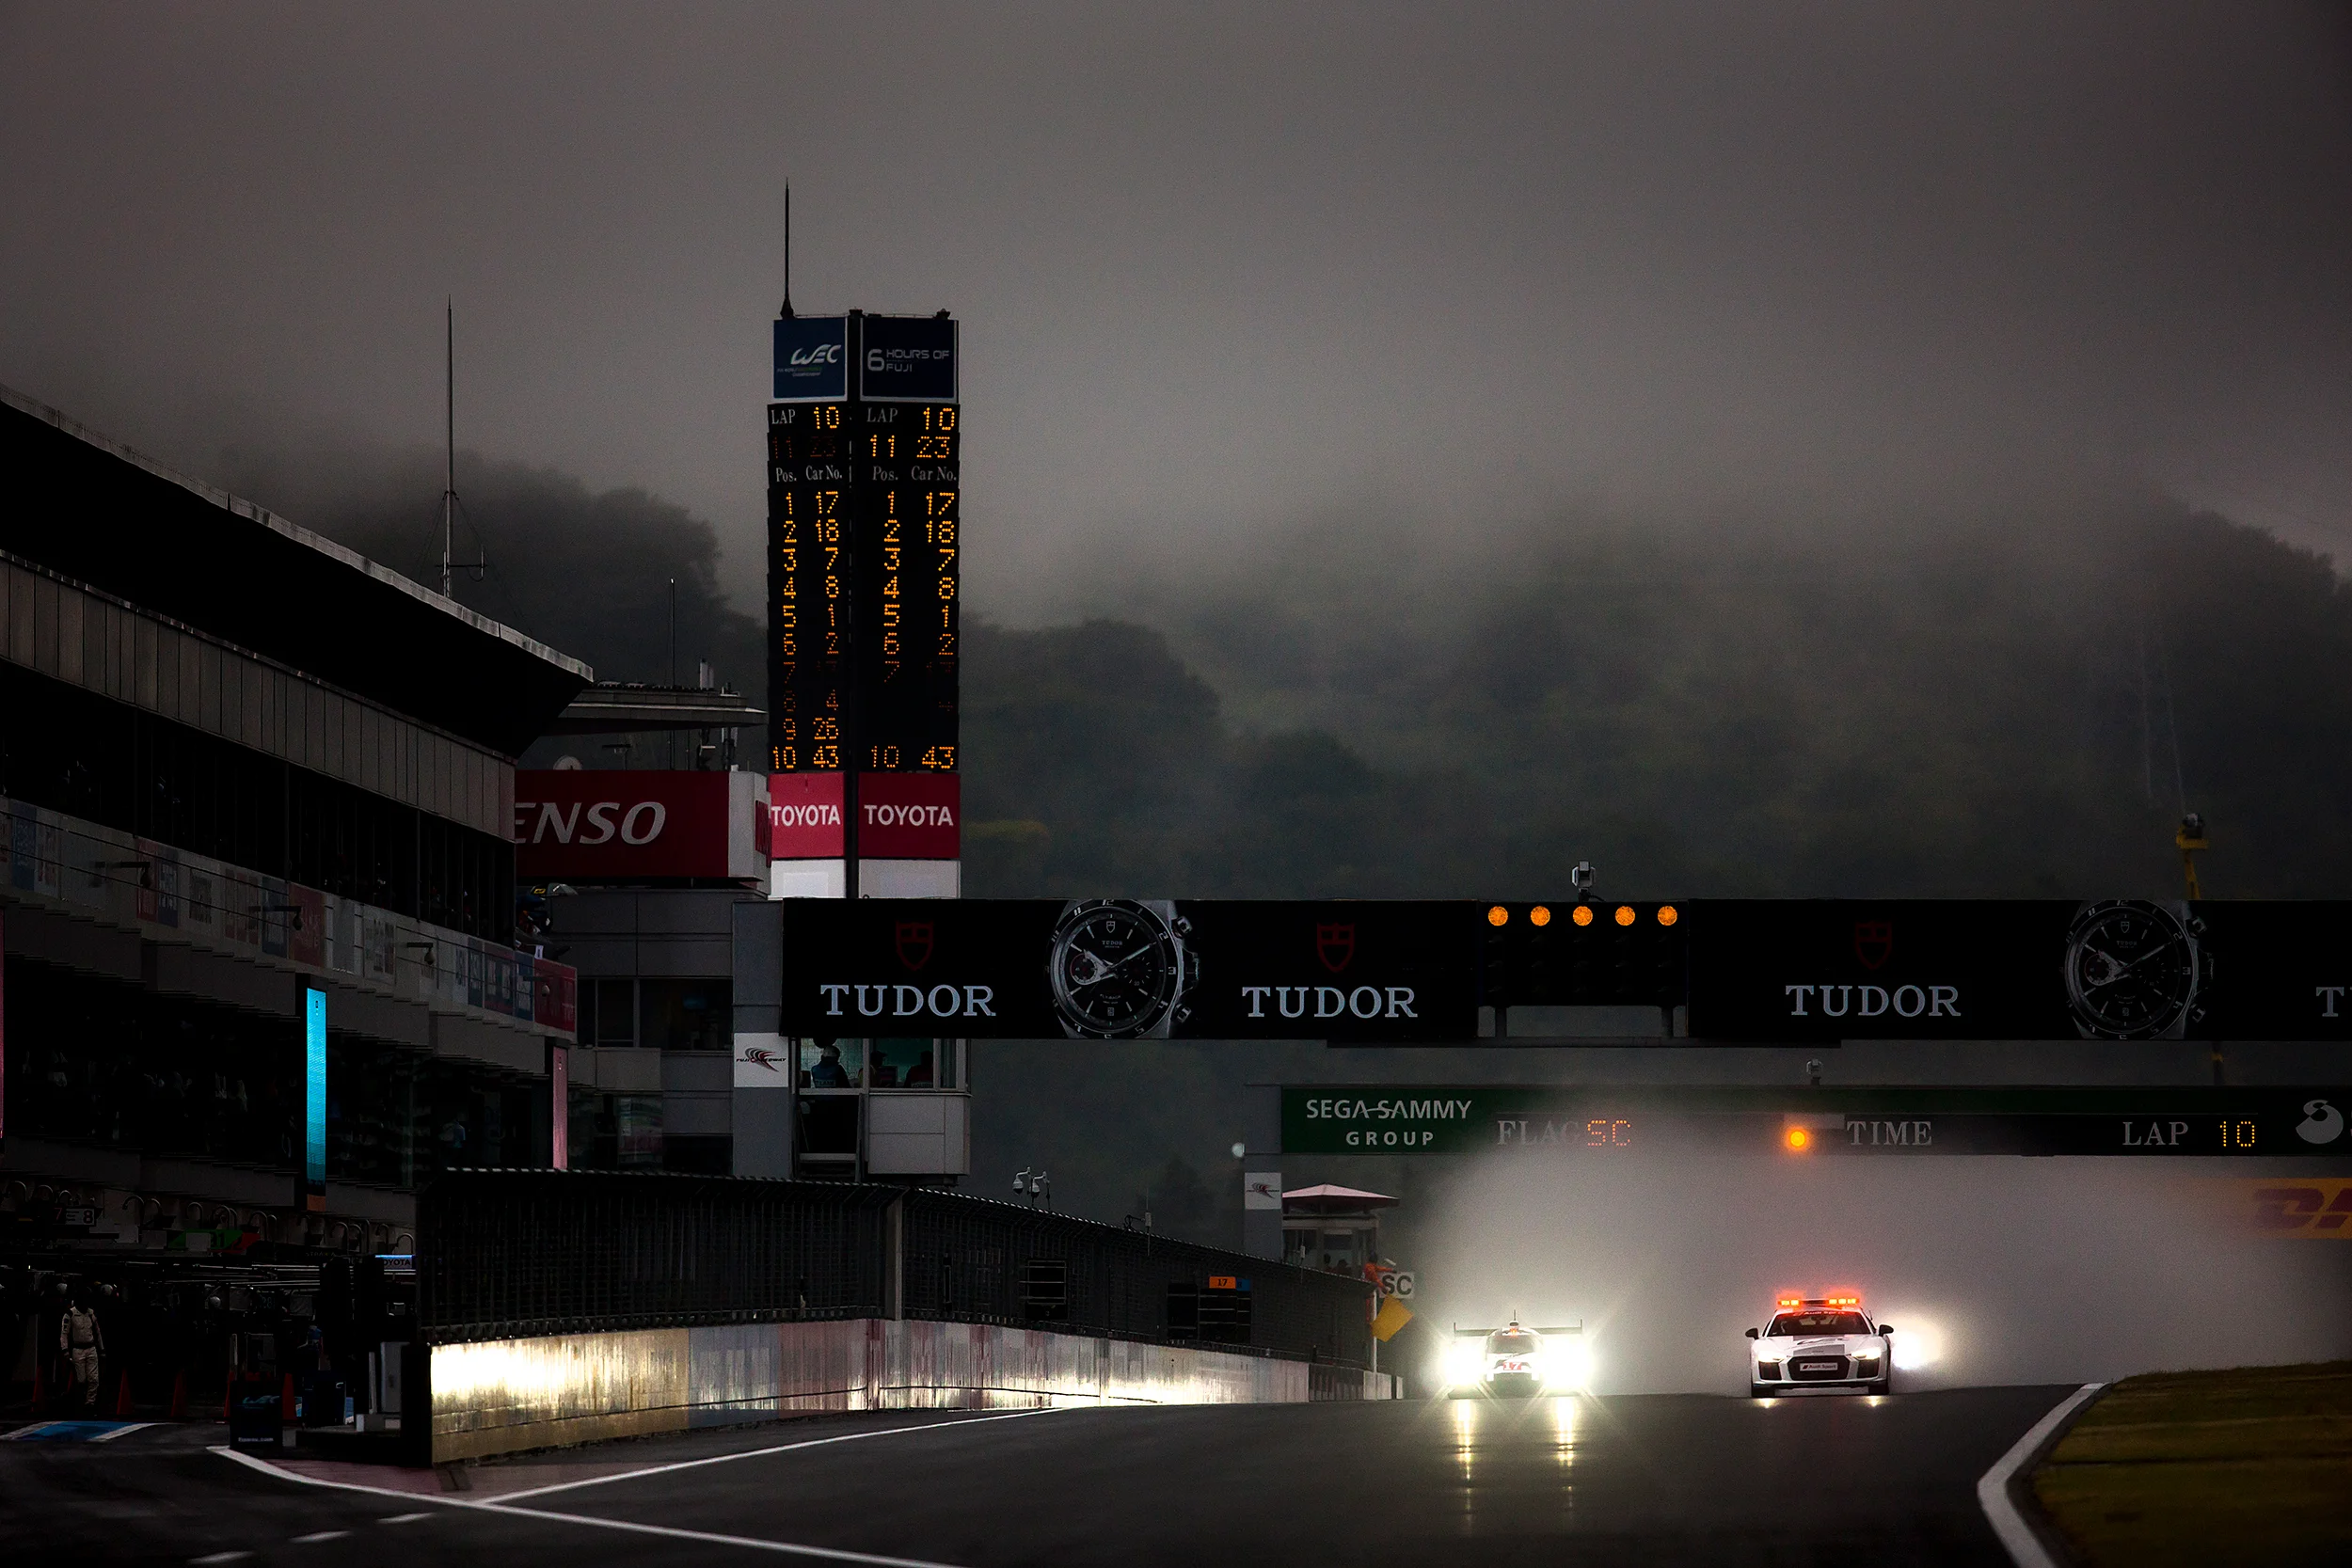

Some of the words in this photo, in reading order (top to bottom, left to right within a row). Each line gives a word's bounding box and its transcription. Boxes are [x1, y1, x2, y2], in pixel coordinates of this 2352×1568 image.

[790, 344, 842, 365] WEC
[867, 348, 884, 372] 6
[885, 349, 930, 359] HOURS
[932, 349, 950, 360] OF
[885, 363, 913, 372] FUJI
[771, 408, 796, 425] LAP
[813, 406, 840, 429] 10
[866, 407, 898, 423] LAP
[923, 407, 955, 431] 10
[870, 434, 895, 457] 11
[916, 436, 950, 458] 23
[775, 466, 798, 483] Pos.
[805, 466, 824, 481] Car
[826, 465, 843, 481] No.
[872, 466, 899, 482] Pos.
[911, 466, 933, 481] Car
[936, 467, 957, 482] No.
[786, 491, 793, 515] 1
[816, 490, 839, 515] 17
[887, 490, 895, 515] 1
[926, 491, 955, 515] 17
[784, 520, 797, 543] 2
[815, 518, 839, 543] 18
[883, 519, 900, 543] 2
[926, 519, 955, 543] 18
[783, 547, 797, 571] 3
[825, 546, 839, 571] 7
[884, 546, 900, 571] 3
[938, 548, 955, 571] 7
[784, 576, 797, 599] 4
[825, 575, 839, 598] 8
[883, 576, 900, 599] 4
[938, 577, 955, 600] 8
[783, 604, 797, 628] 5
[828, 603, 835, 626] 1
[883, 604, 899, 626] 5
[942, 604, 948, 628] 1
[783, 632, 797, 656] 6
[825, 632, 839, 656] 2
[883, 632, 899, 656] 6
[939, 633, 955, 656] 2
[783, 661, 796, 685] 7
[883, 661, 900, 685] 7
[825, 689, 839, 711] 4
[783, 718, 797, 741] 9
[813, 717, 839, 740] 26
[771, 745, 797, 769] 10
[813, 745, 839, 769] 43
[871, 745, 899, 769] 10
[922, 745, 955, 769] 43
[771, 804, 841, 827] TOYOTA
[864, 804, 954, 827] TOYOTA
[820, 984, 997, 1017] TUDOR
[1241, 985, 1419, 1019] TUDOR
[1785, 985, 1963, 1018] TUDOR
[2316, 986, 2352, 1017] T
[1306, 1099, 1370, 1119] SEGA
[1377, 1099, 1472, 1119] SAMMY
[1345, 1131, 1435, 1146] GROUP
[1587, 1119, 1630, 1147] SC
[1847, 1120, 1932, 1146] TIME
[2122, 1120, 2189, 1146] LAP
[2218, 1120, 2256, 1148] 10
[1218, 1278, 1228, 1287] 17
[1381, 1274, 1412, 1296] SC
[1505, 1362, 1520, 1371] 17
